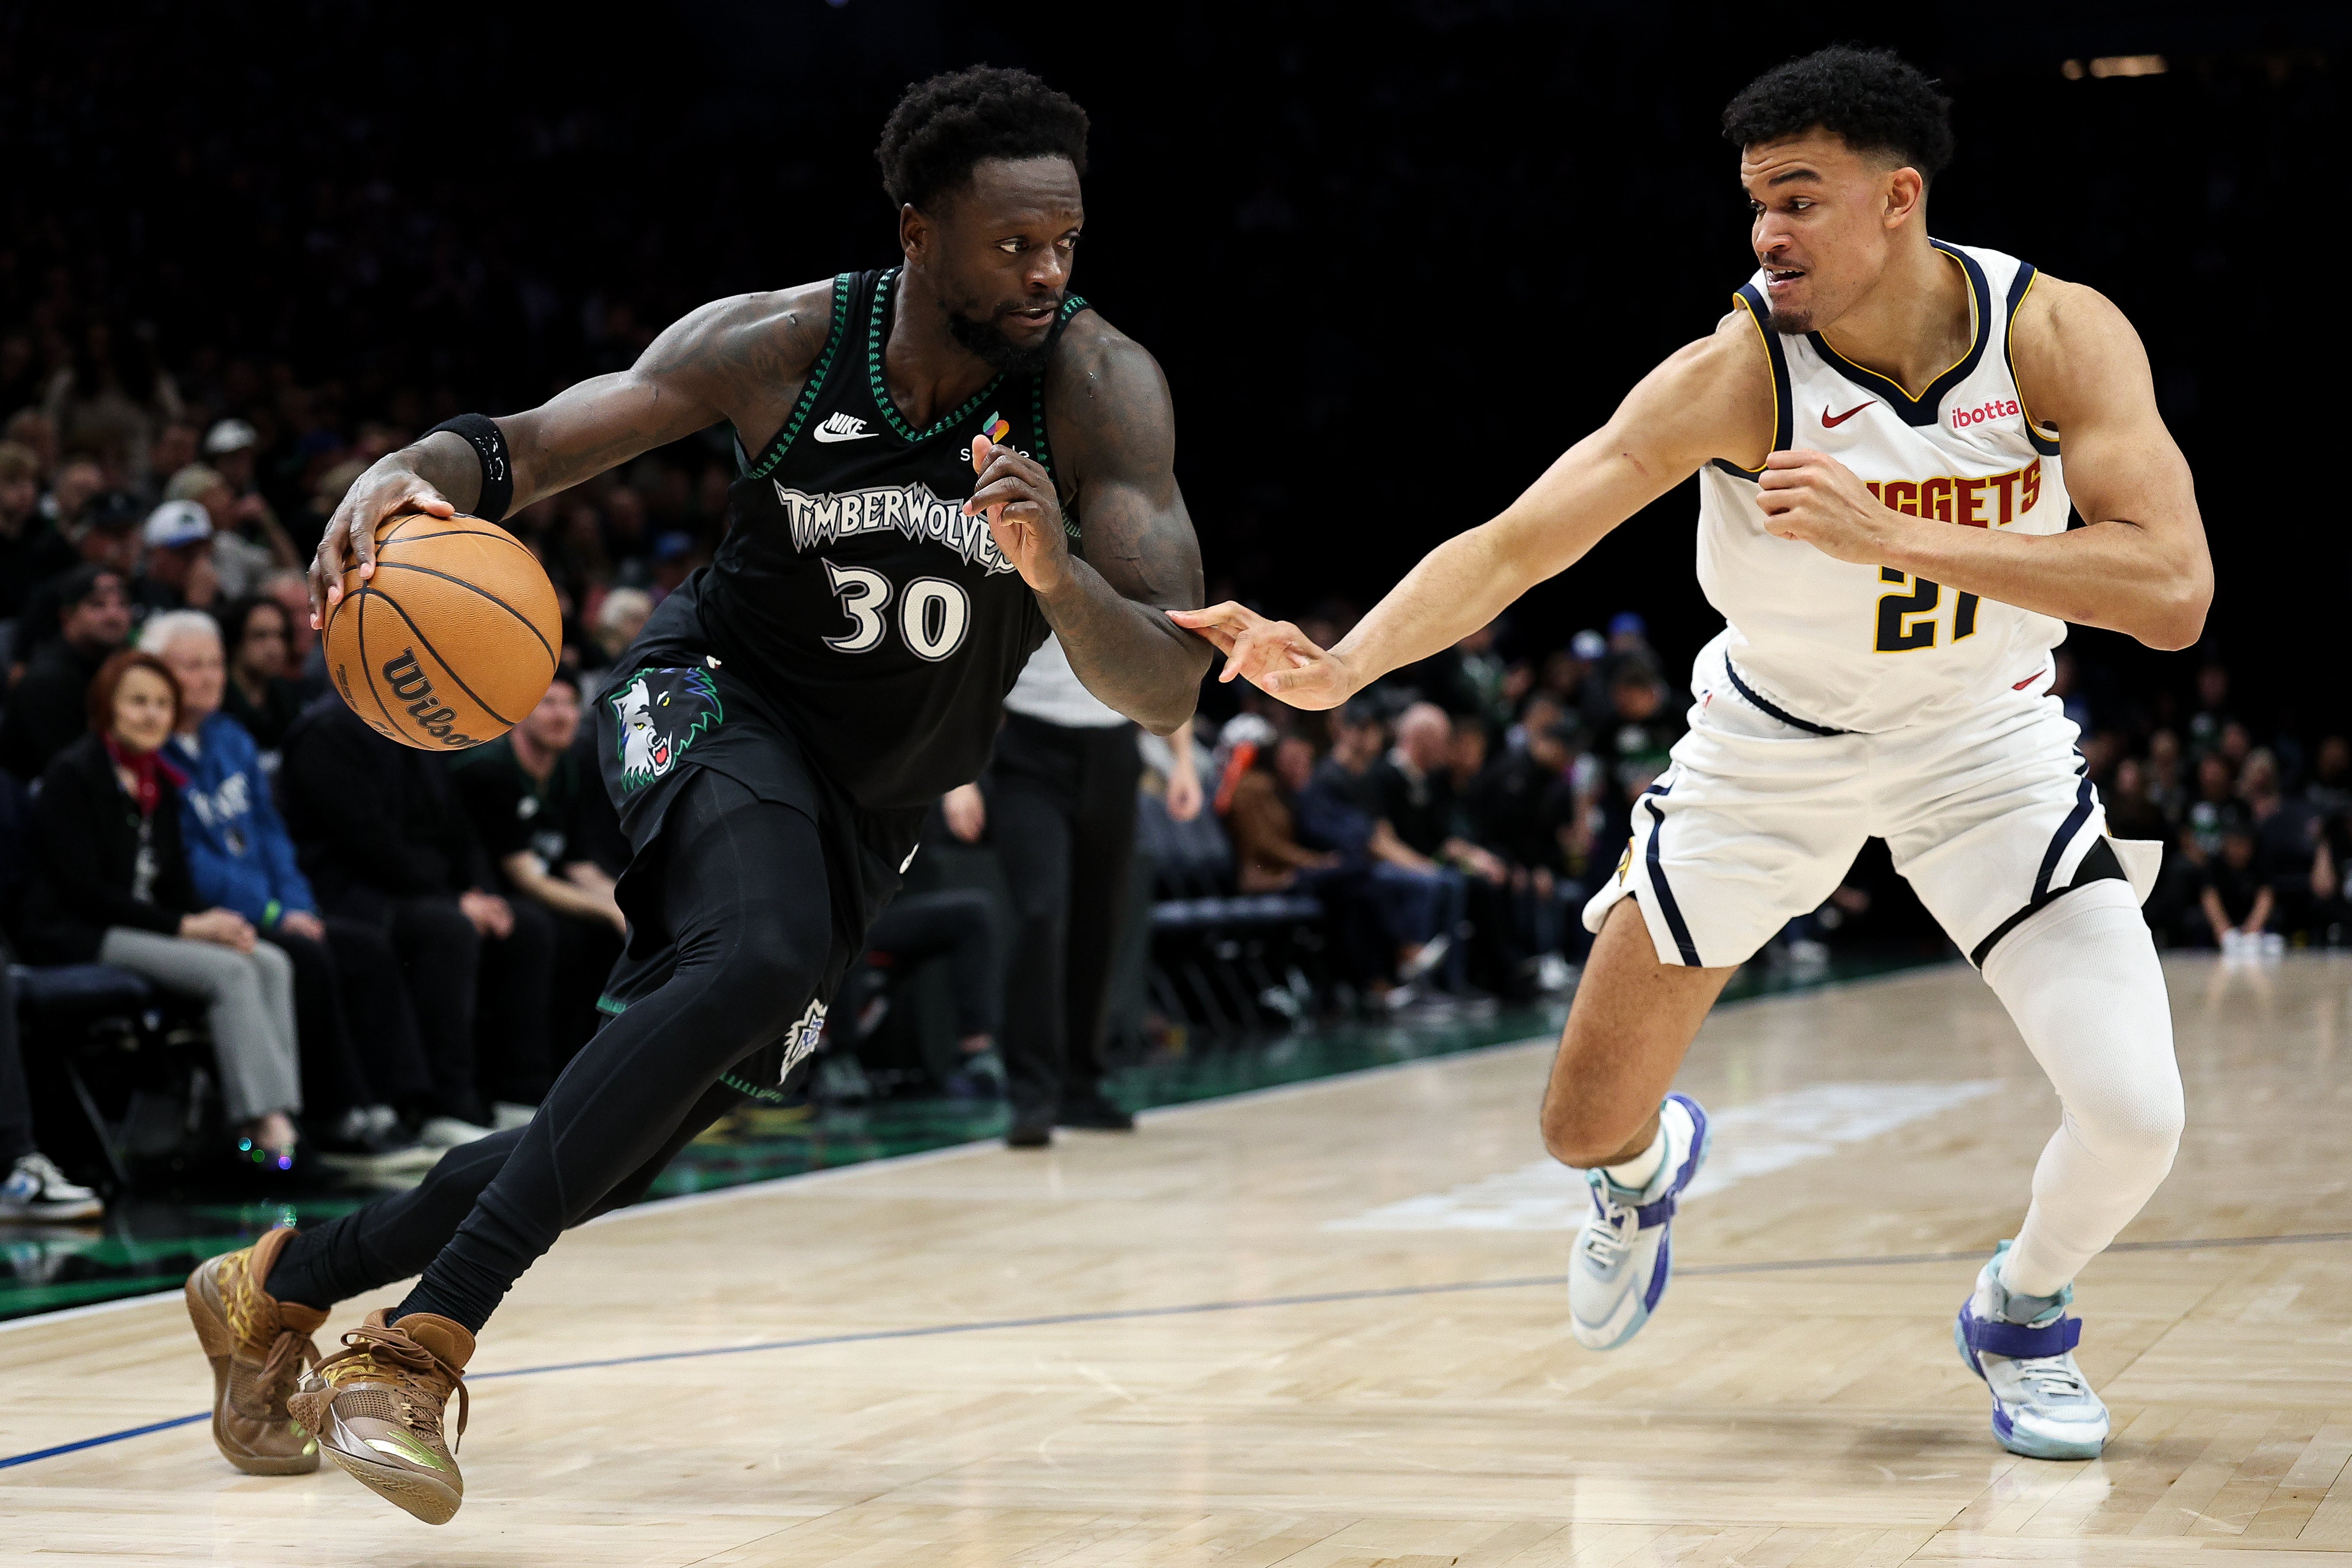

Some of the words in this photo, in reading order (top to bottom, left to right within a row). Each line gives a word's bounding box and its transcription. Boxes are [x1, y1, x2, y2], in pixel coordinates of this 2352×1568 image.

[825, 412, 867, 435] NIKE
[1952, 400, 2019, 428] ibotta
[1865, 454, 2041, 529] GGETS
[821, 557, 971, 662] 30
